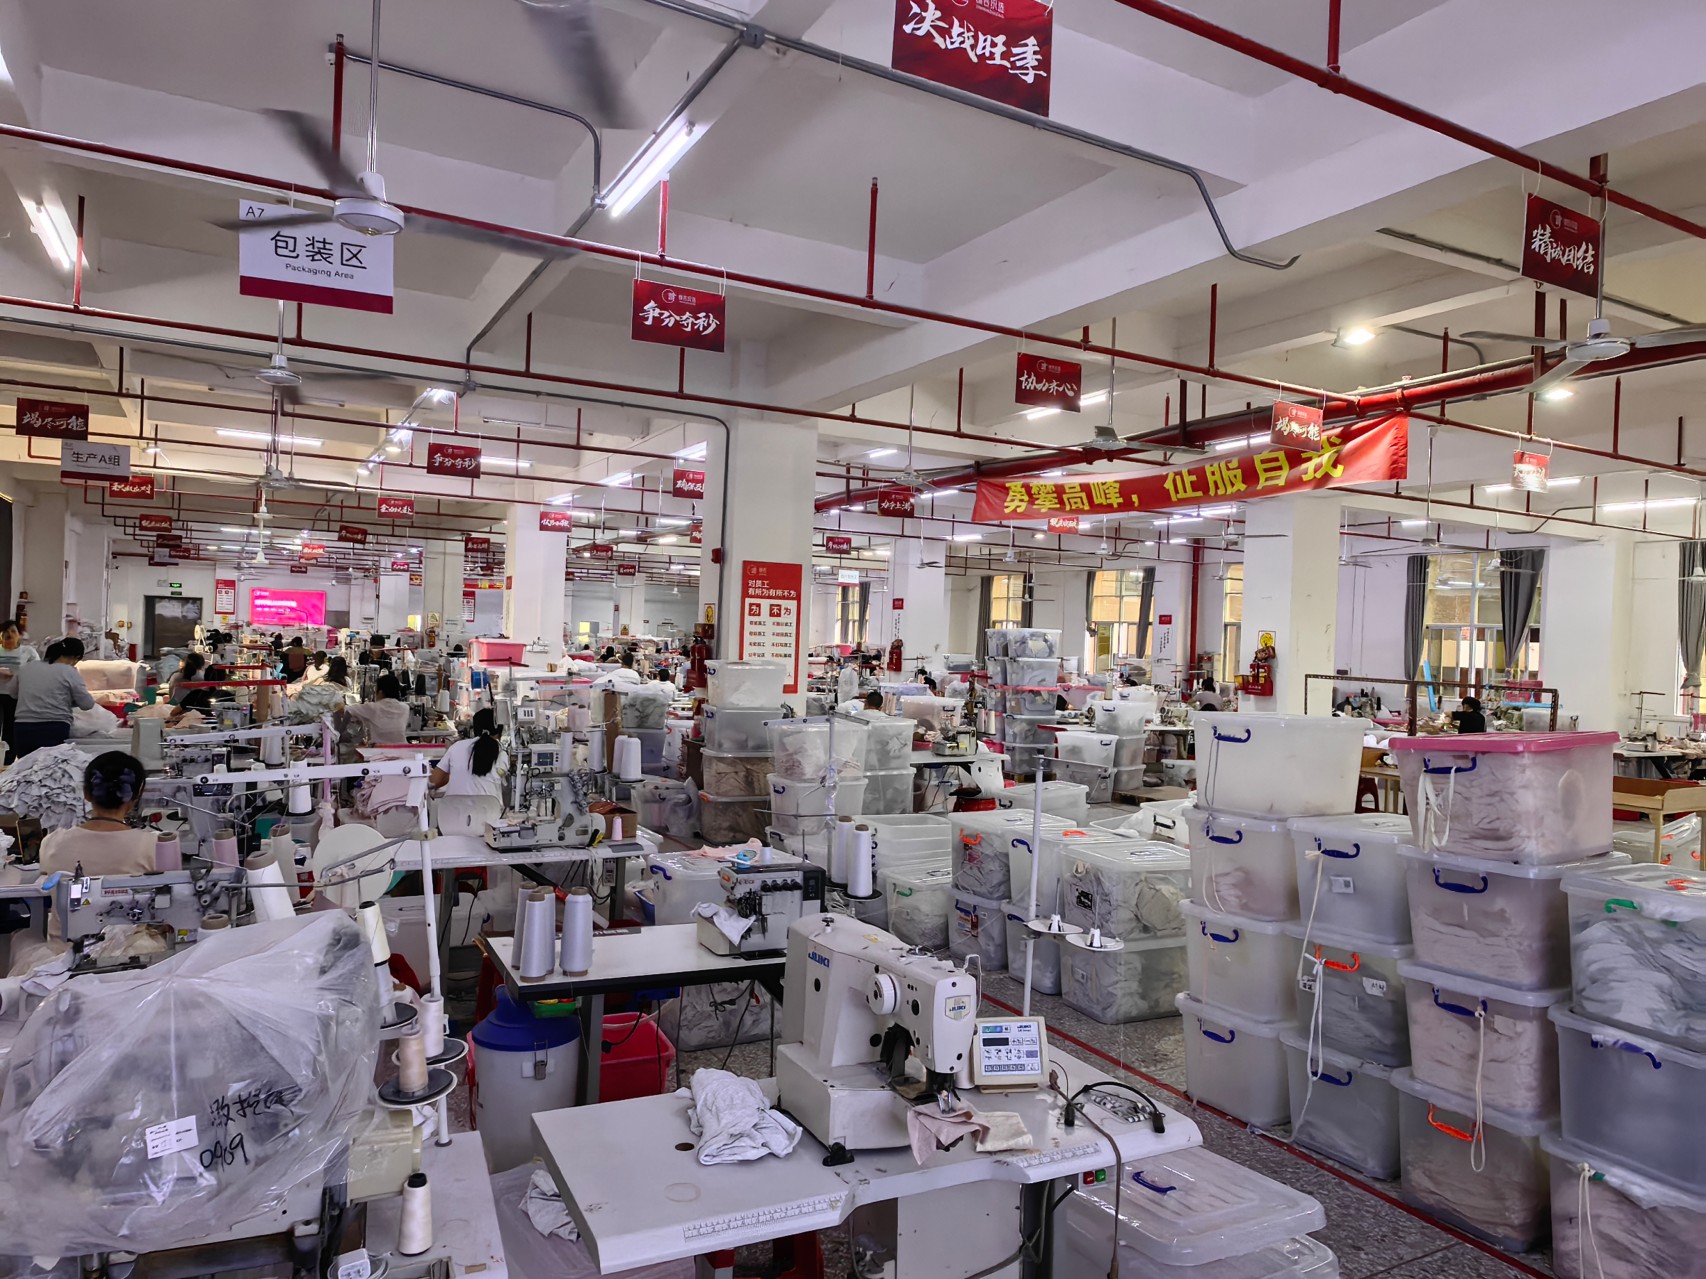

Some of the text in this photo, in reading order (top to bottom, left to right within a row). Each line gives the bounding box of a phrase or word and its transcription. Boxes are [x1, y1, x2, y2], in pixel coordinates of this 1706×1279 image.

[903, 0, 1047, 83] 决战旺季
[246, 206, 265, 218] A7
[270, 231, 367, 269] 包装区
[1531, 224, 1595, 275] 精诚团结
[285, 263, 354, 280] Packaging Area
[639, 300, 720, 335] 争分夺秒
[1019, 370, 1077, 396] 协力齐心
[22, 411, 87, 431] 竭尽可能
[72, 451, 121, 467] 生产A组
[748, 580, 769, 588] 对员工
[748, 588, 796, 597] 有所为有所不为
[750, 605, 759, 614] 为
[807, 951, 829, 968] JUKI
